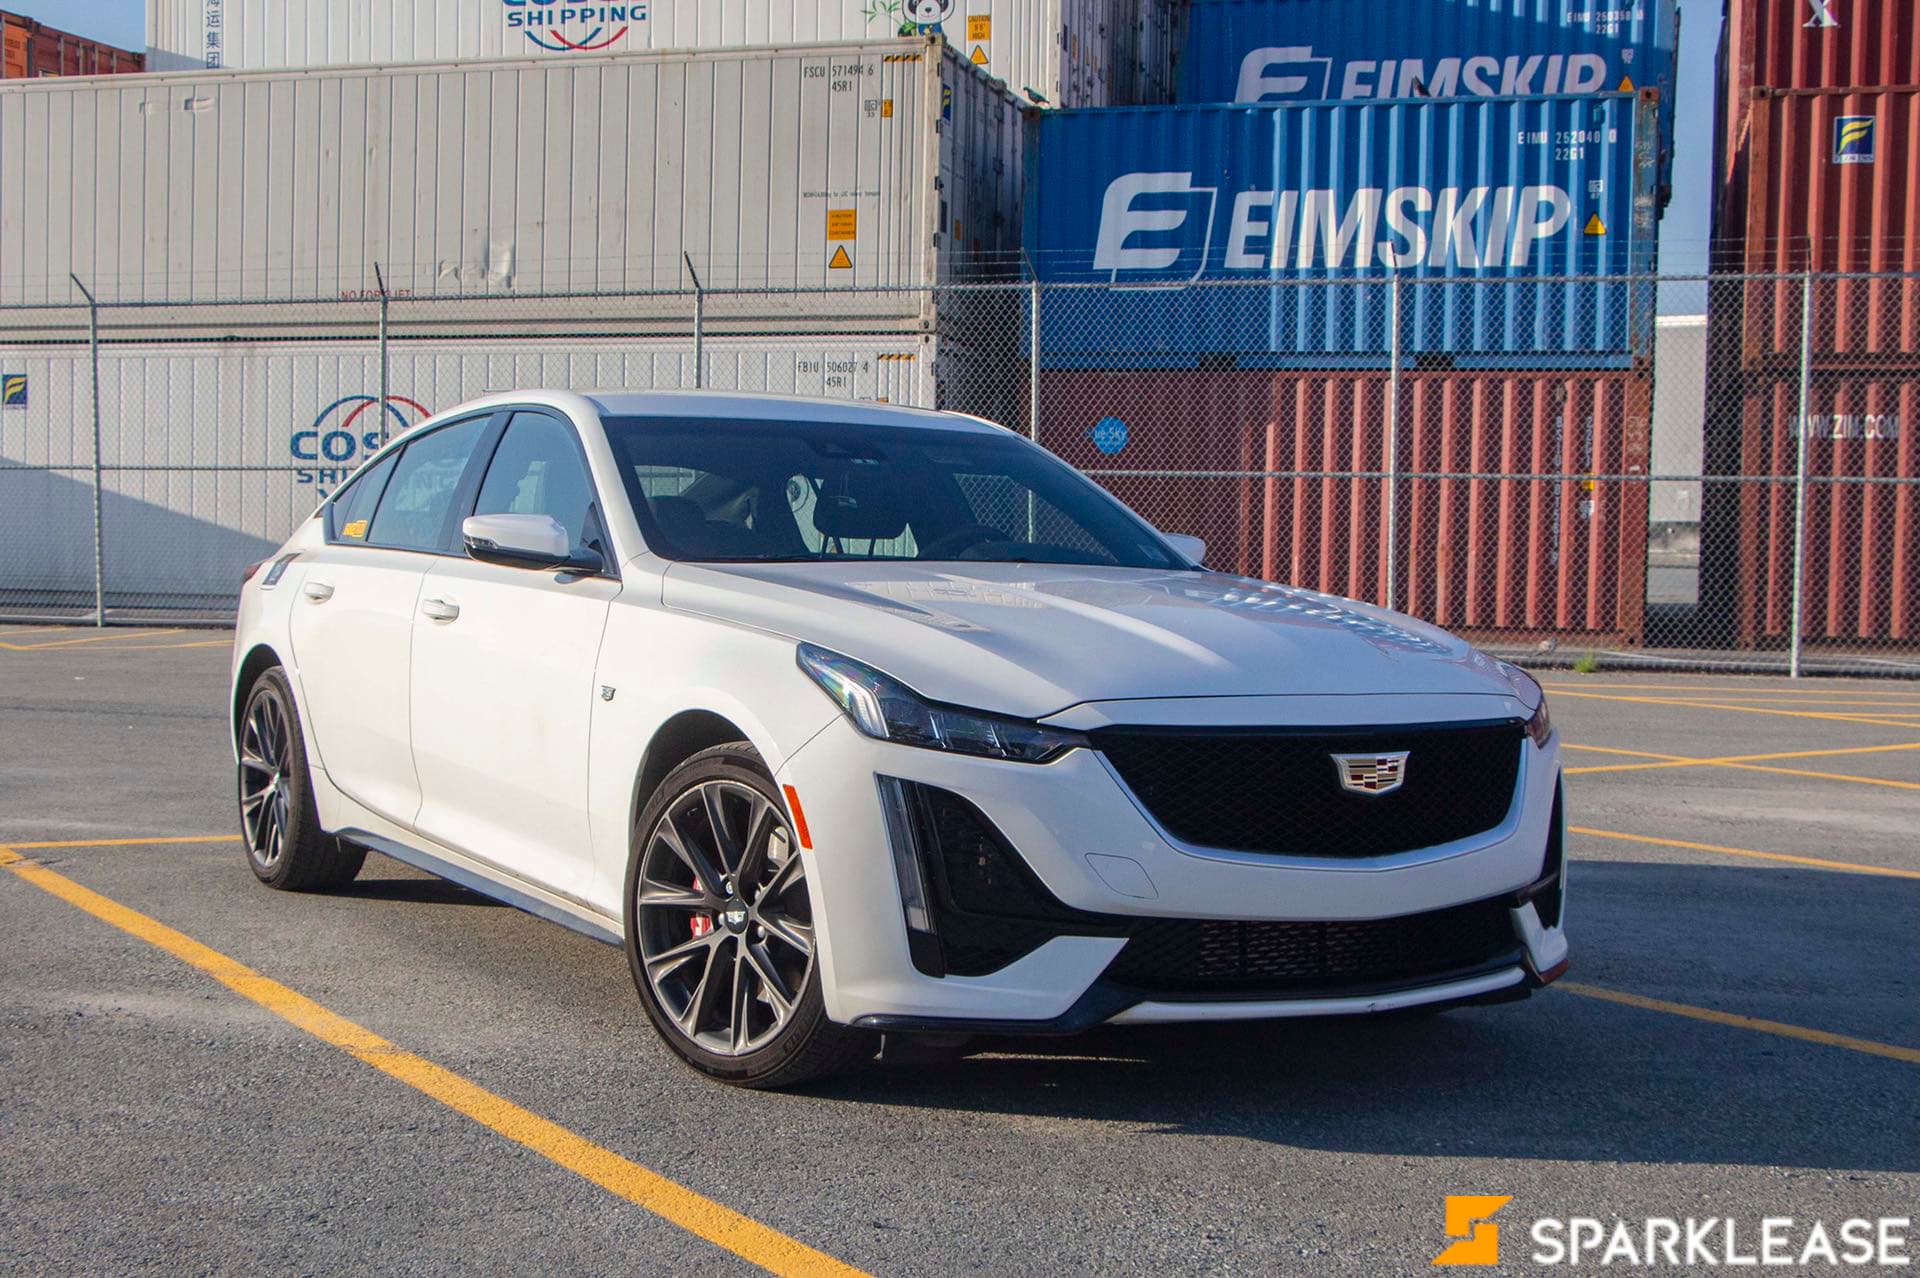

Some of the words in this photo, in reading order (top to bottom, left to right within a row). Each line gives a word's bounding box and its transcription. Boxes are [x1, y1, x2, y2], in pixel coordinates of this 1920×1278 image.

[508, 6, 647, 27] SHIPPING
[804, 66, 826, 78] FSCU
[832, 65, 864, 77] 571494
[867, 64, 874, 76] 6
[1340, 53, 1607, 99] EIMSKIP
[831, 81, 852, 92] 45R1
[1517, 131, 1548, 145] EIMU
[1555, 130, 1601, 144] 252040
[1555, 147, 1584, 160] 22G1
[1224, 185, 1571, 268] EIMSKIP
[341, 289, 357, 298] NO
[798, 361, 819, 373] FBIU
[826, 361, 858, 373] 506027
[862, 361, 869, 373] 4
[826, 377, 847, 388] 45R1
